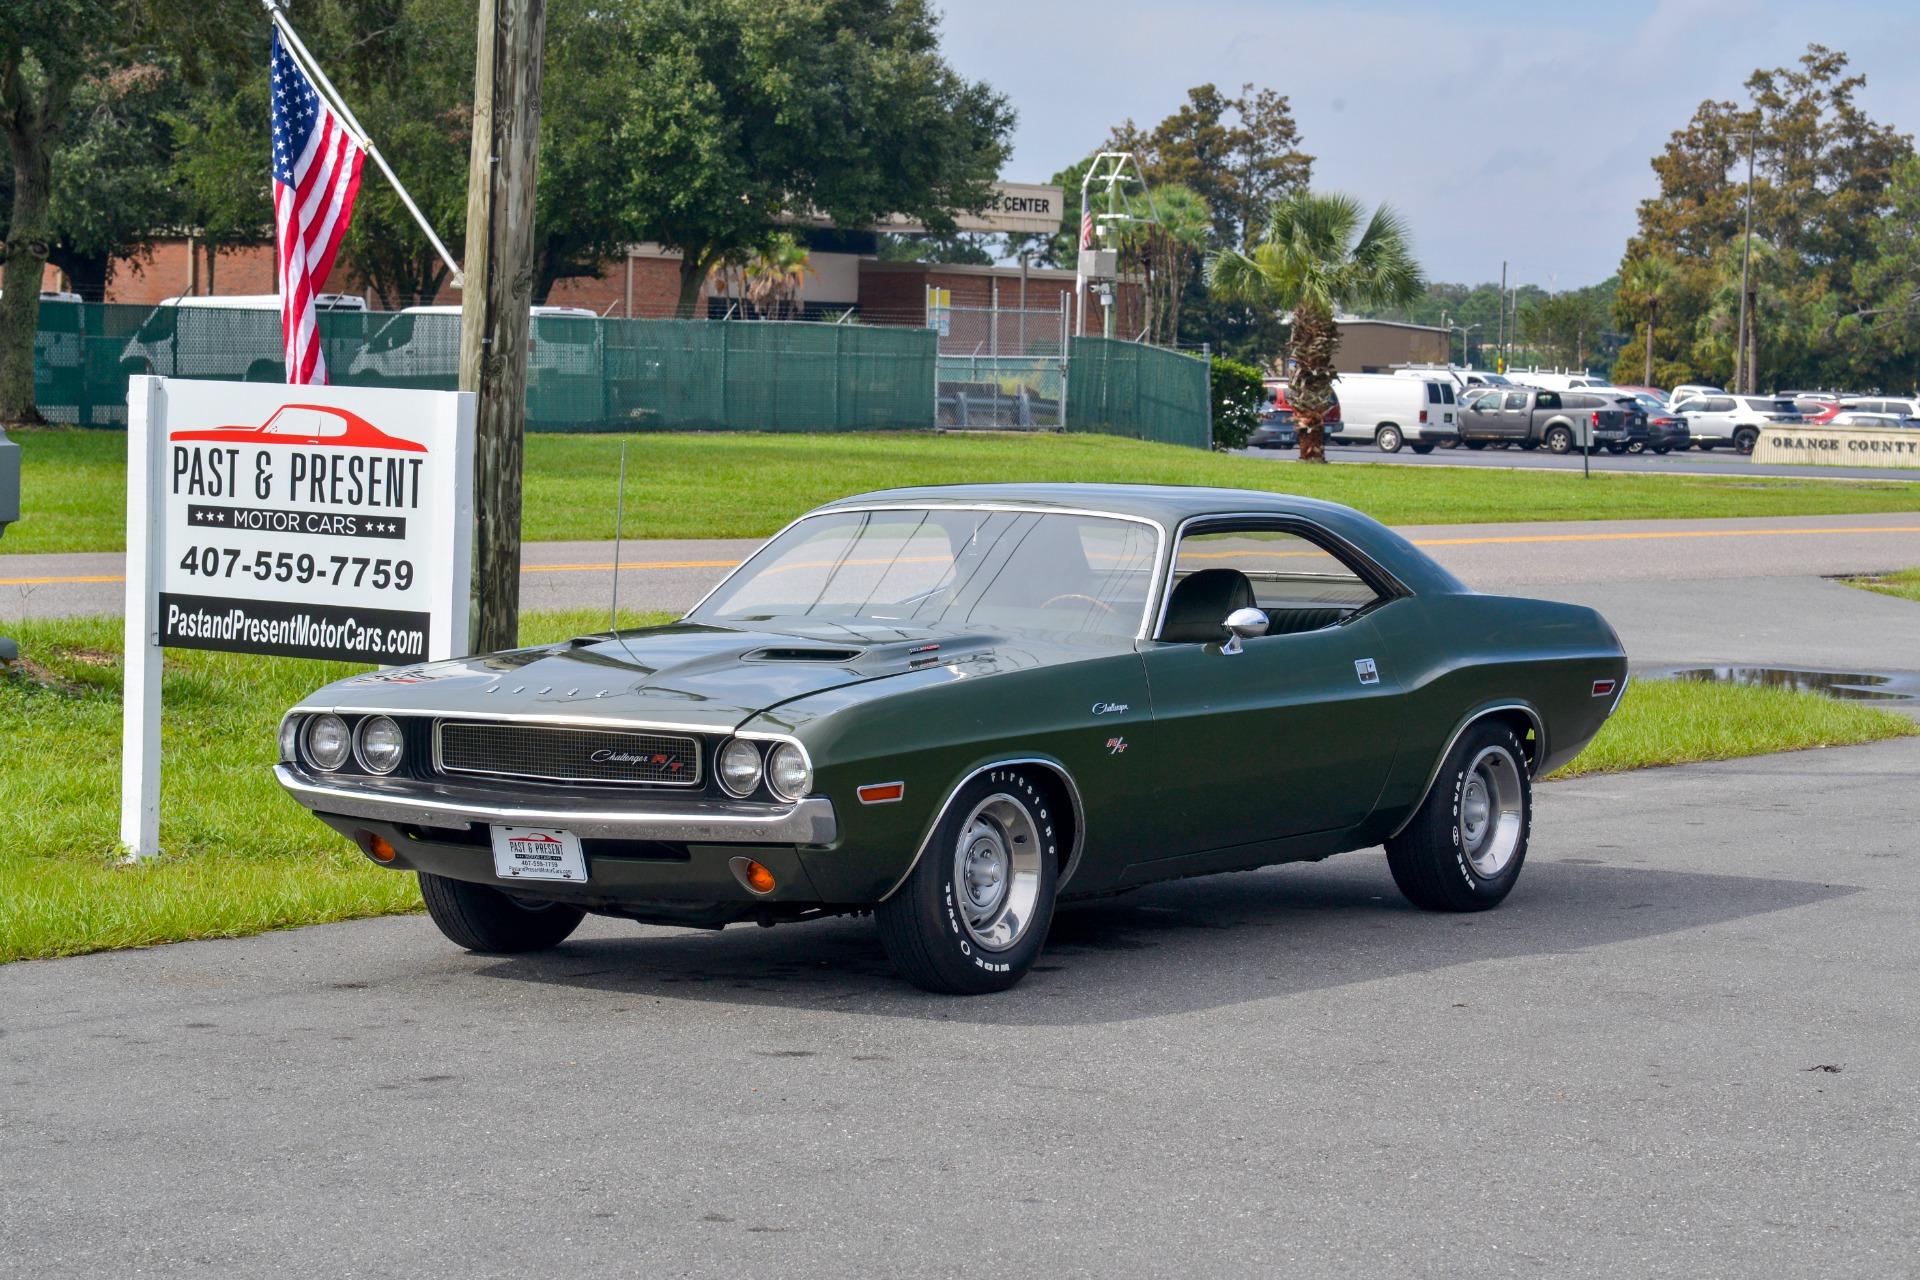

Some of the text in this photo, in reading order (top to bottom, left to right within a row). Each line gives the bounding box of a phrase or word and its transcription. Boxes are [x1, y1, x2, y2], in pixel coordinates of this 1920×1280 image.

[1004, 196, 1050, 213] CENTER
[1772, 437, 1917, 453] ORANGE COUNTY
[173, 446, 424, 508] PAST & PRESENT
[233, 510, 357, 535] MOTOR CARS
[180, 545, 415, 591] 407-559-7759
[167, 604, 423, 656] PastandPresentMotorCars.com
[590, 749, 648, 765] Challenger
[509, 841, 526, 853] PAST
[535, 843, 563, 855] PRESENT
[975, 957, 1010, 972] WIDE
